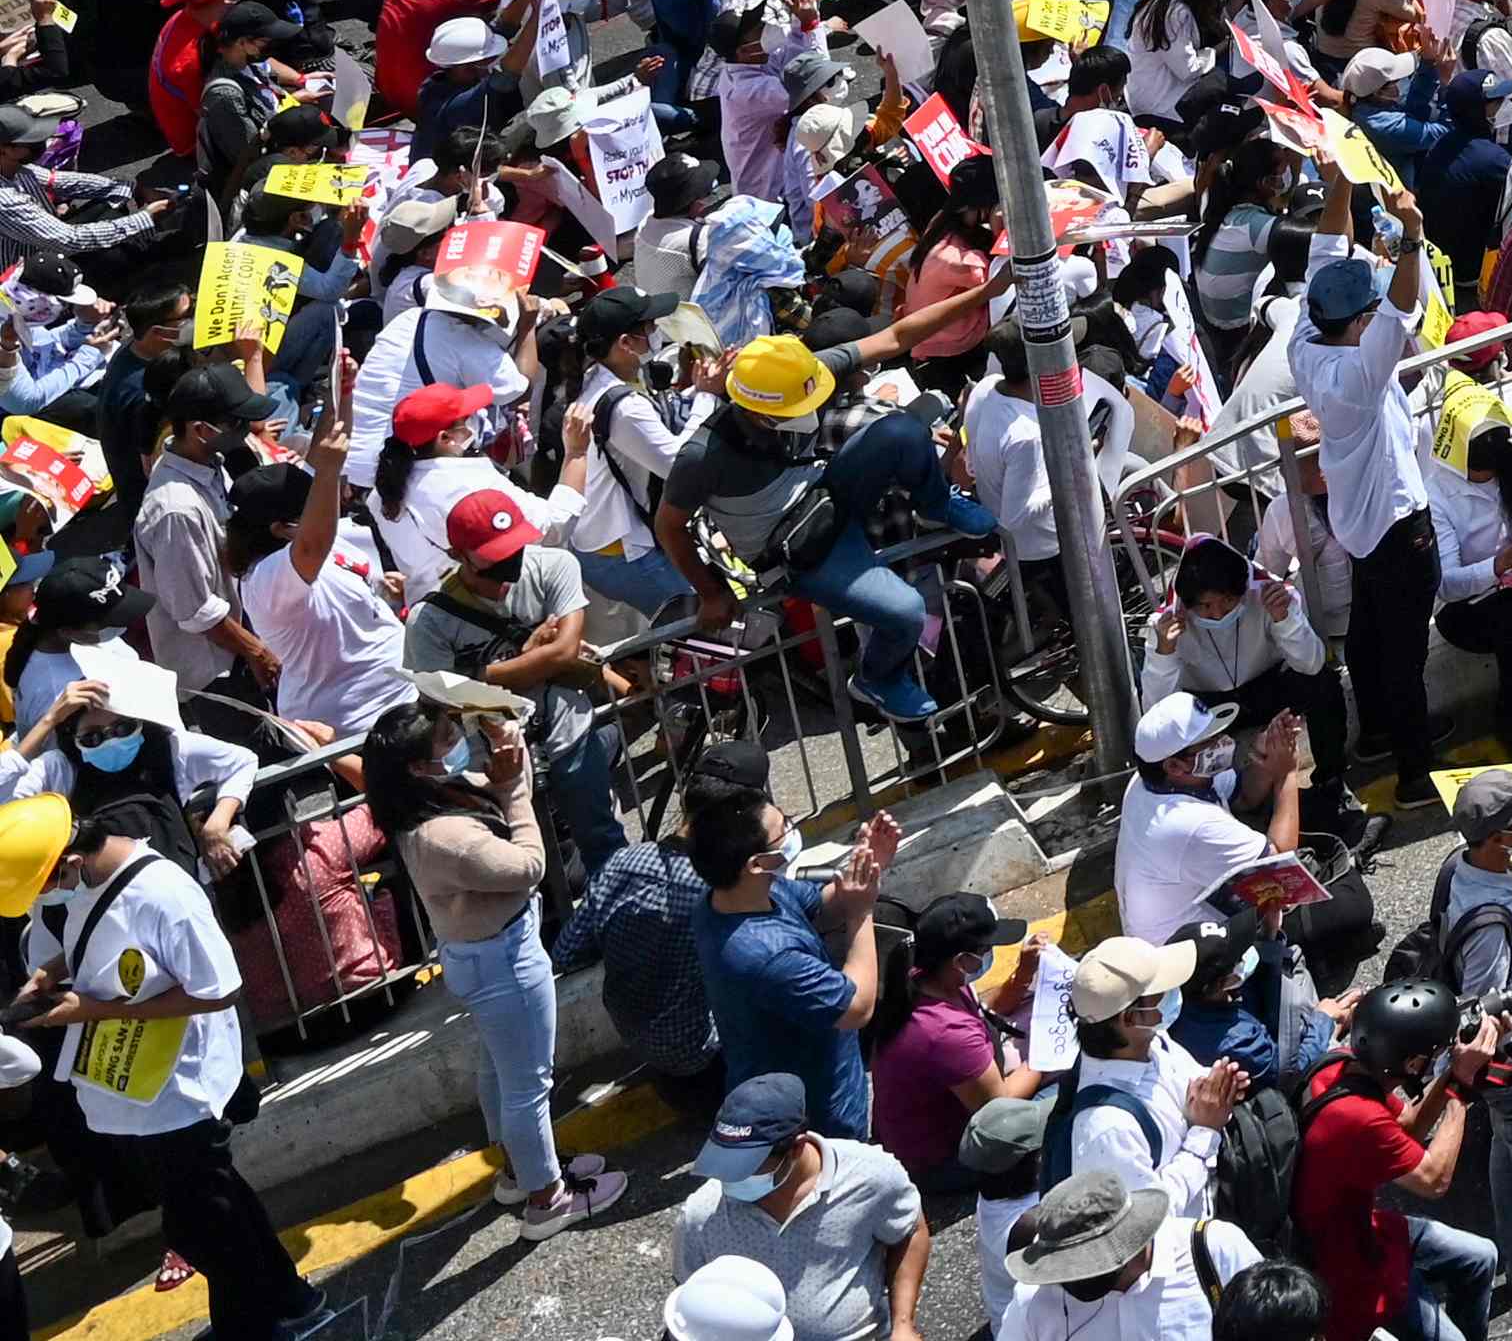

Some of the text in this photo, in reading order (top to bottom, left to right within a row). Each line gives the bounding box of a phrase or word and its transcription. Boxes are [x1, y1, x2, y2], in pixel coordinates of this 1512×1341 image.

[540, 16, 562, 35] STOP
[605, 164, 636, 186] STOP
[448, 228, 469, 261] FREE
[516, 231, 541, 277] LEADER
[243, 250, 258, 283] COUP
[207, 247, 239, 341] We Don't Accept
[12, 440, 39, 461] FREE
[103, 1024, 128, 1086] AUNG SAN
